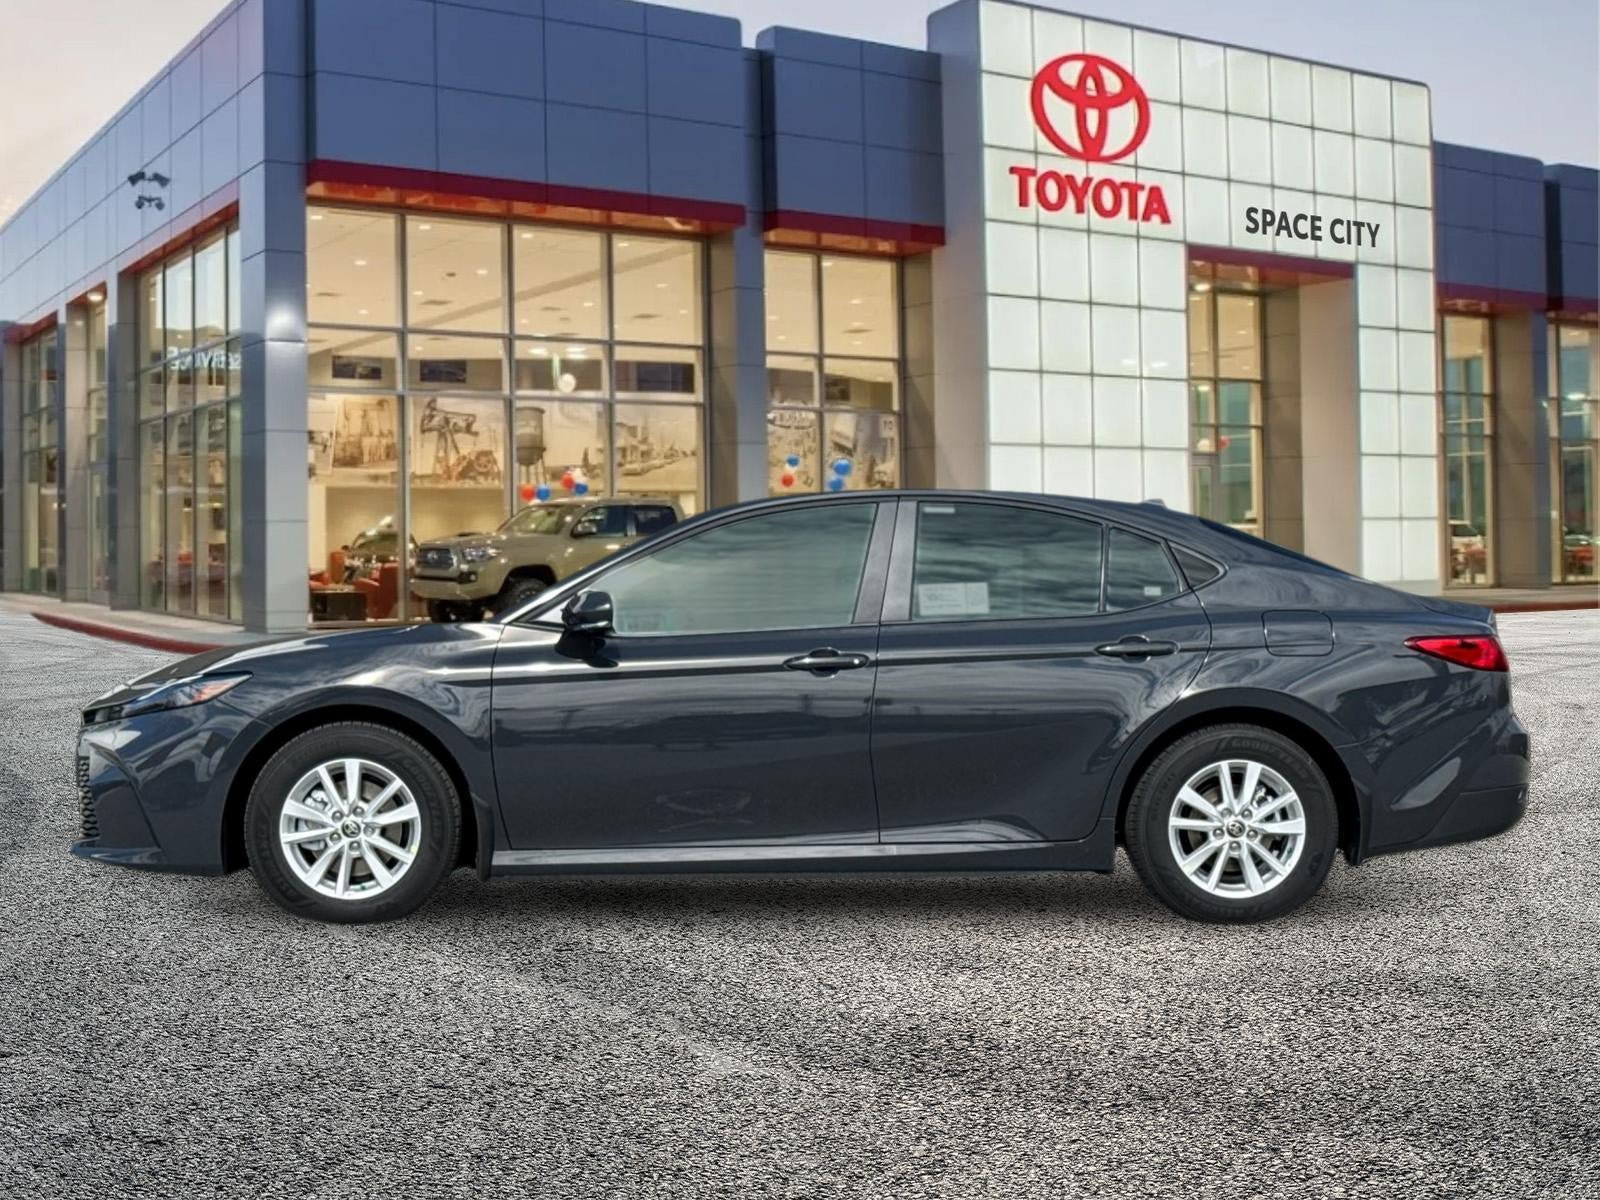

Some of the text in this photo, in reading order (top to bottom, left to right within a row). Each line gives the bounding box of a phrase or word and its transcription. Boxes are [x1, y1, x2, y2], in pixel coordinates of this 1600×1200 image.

[1010, 165, 1170, 224] TOYOTA
[1245, 206, 1380, 248] SPACE CITY
